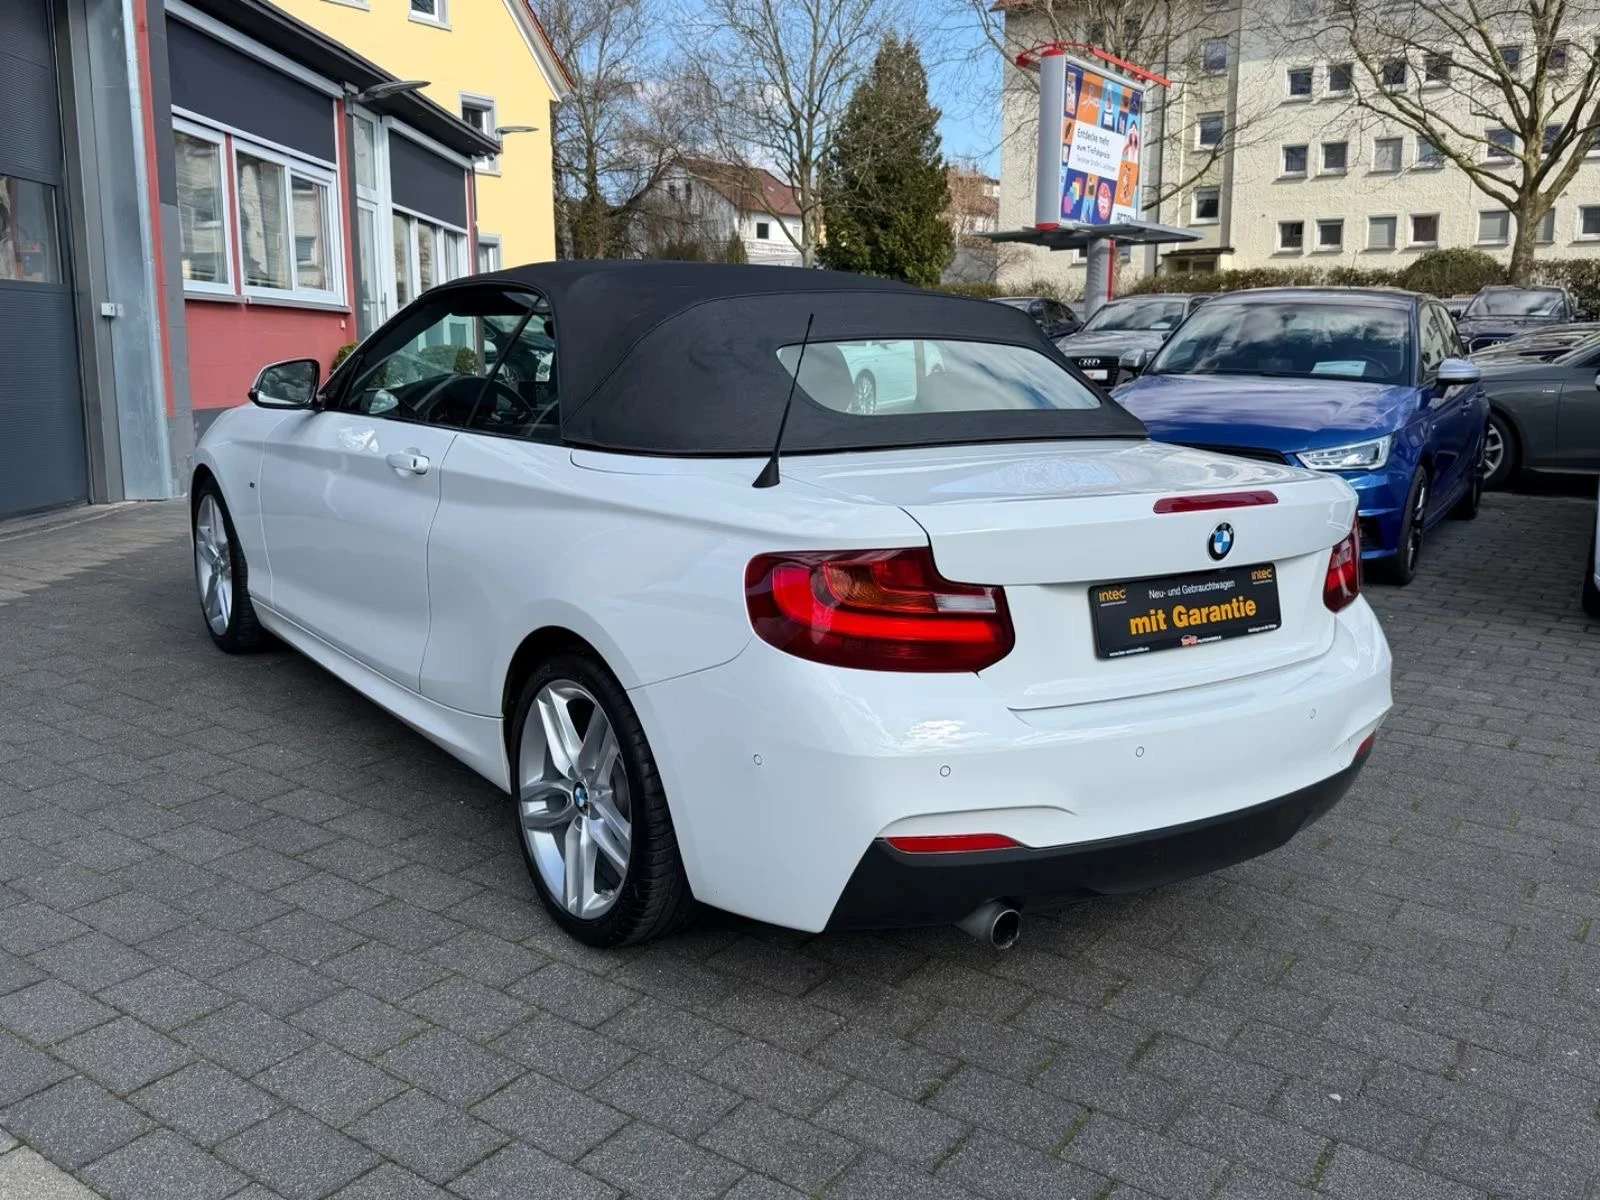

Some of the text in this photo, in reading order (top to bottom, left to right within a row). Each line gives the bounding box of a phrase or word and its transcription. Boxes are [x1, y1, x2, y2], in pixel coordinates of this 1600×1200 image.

[1251, 568, 1273, 580] intec
[1099, 588, 1126, 602] intec
[1148, 580, 1236, 599] Neu- und Gebrauchtwagen
[1129, 596, 1257, 635] mit Garantie
